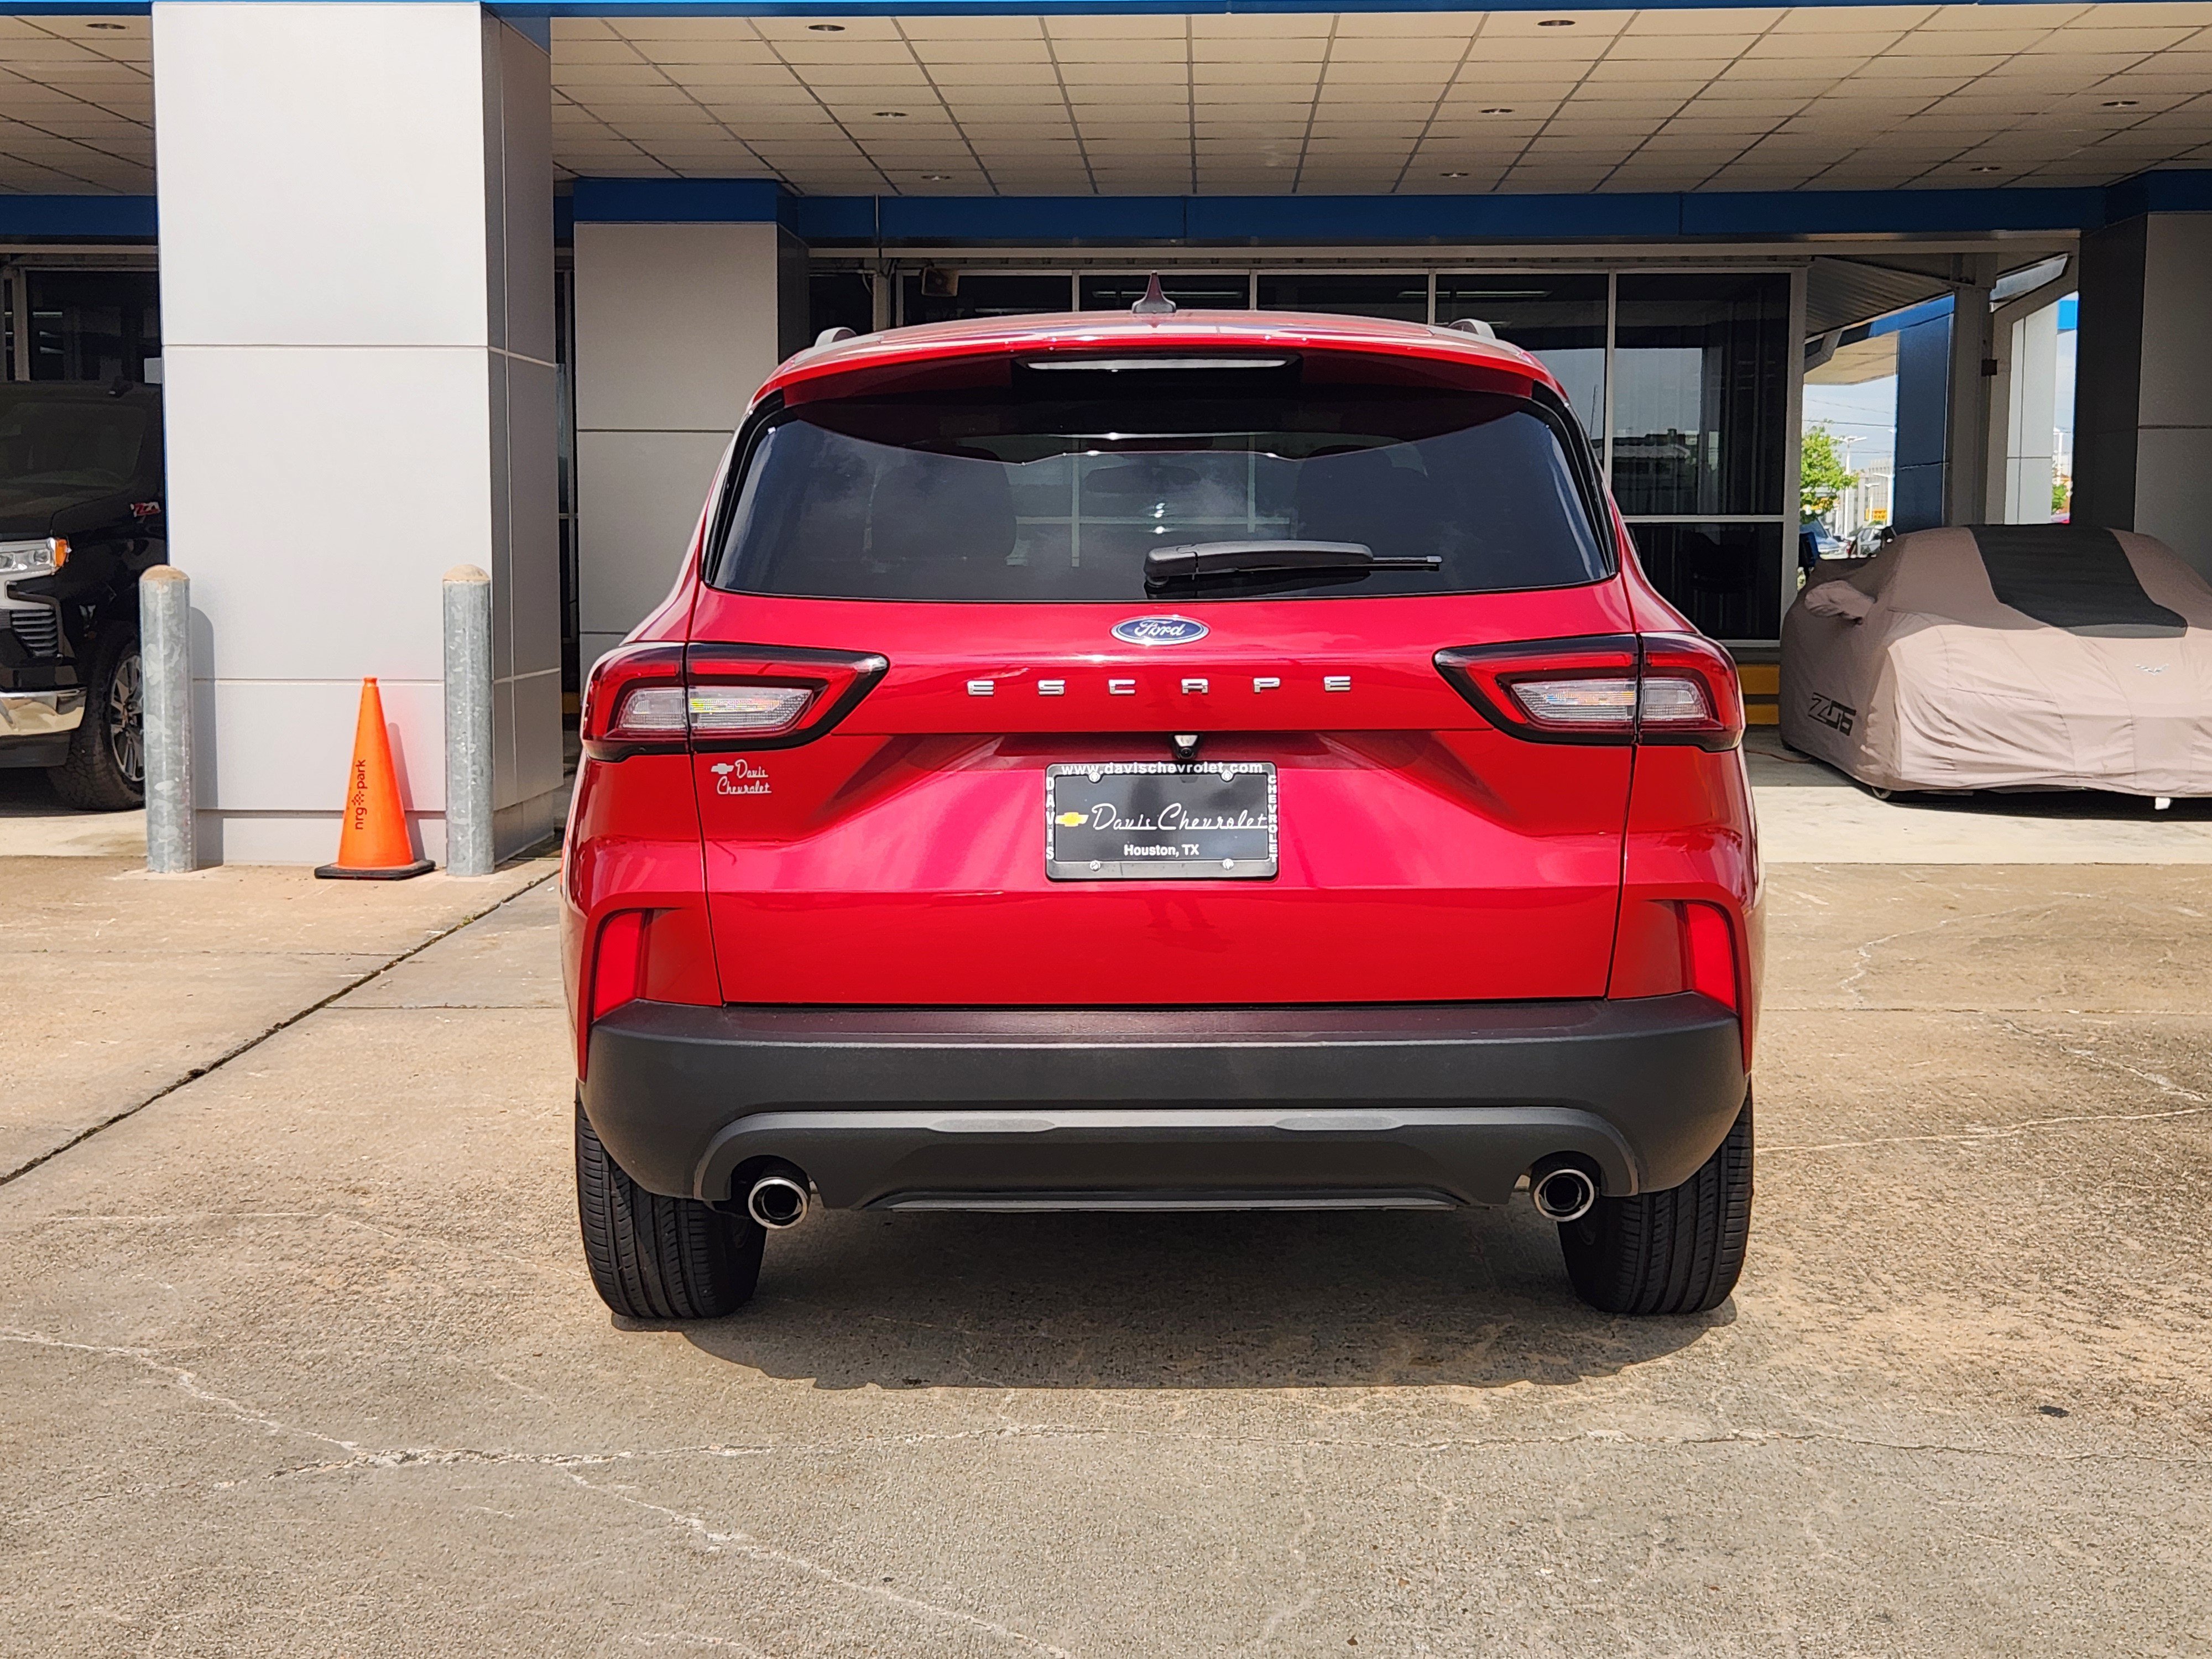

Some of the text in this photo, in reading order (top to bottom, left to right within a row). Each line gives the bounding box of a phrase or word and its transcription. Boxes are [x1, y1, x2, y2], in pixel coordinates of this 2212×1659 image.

[1134, 617, 1186, 637] Ford
[967, 676, 1351, 696] ESCAPE
[734, 759, 769, 779] Davis
[1061, 762, 1263, 774] www.davischevrolet.com
[354, 759, 368, 830] nrg park
[717, 775, 772, 795] Chevrolet
[1046, 777, 1055, 860] DAVIS
[1091, 803, 1269, 830] Davis Chevrolet
[1268, 775, 1277, 863] CHEVROLET
[1124, 844, 1199, 857] Houston, TX
